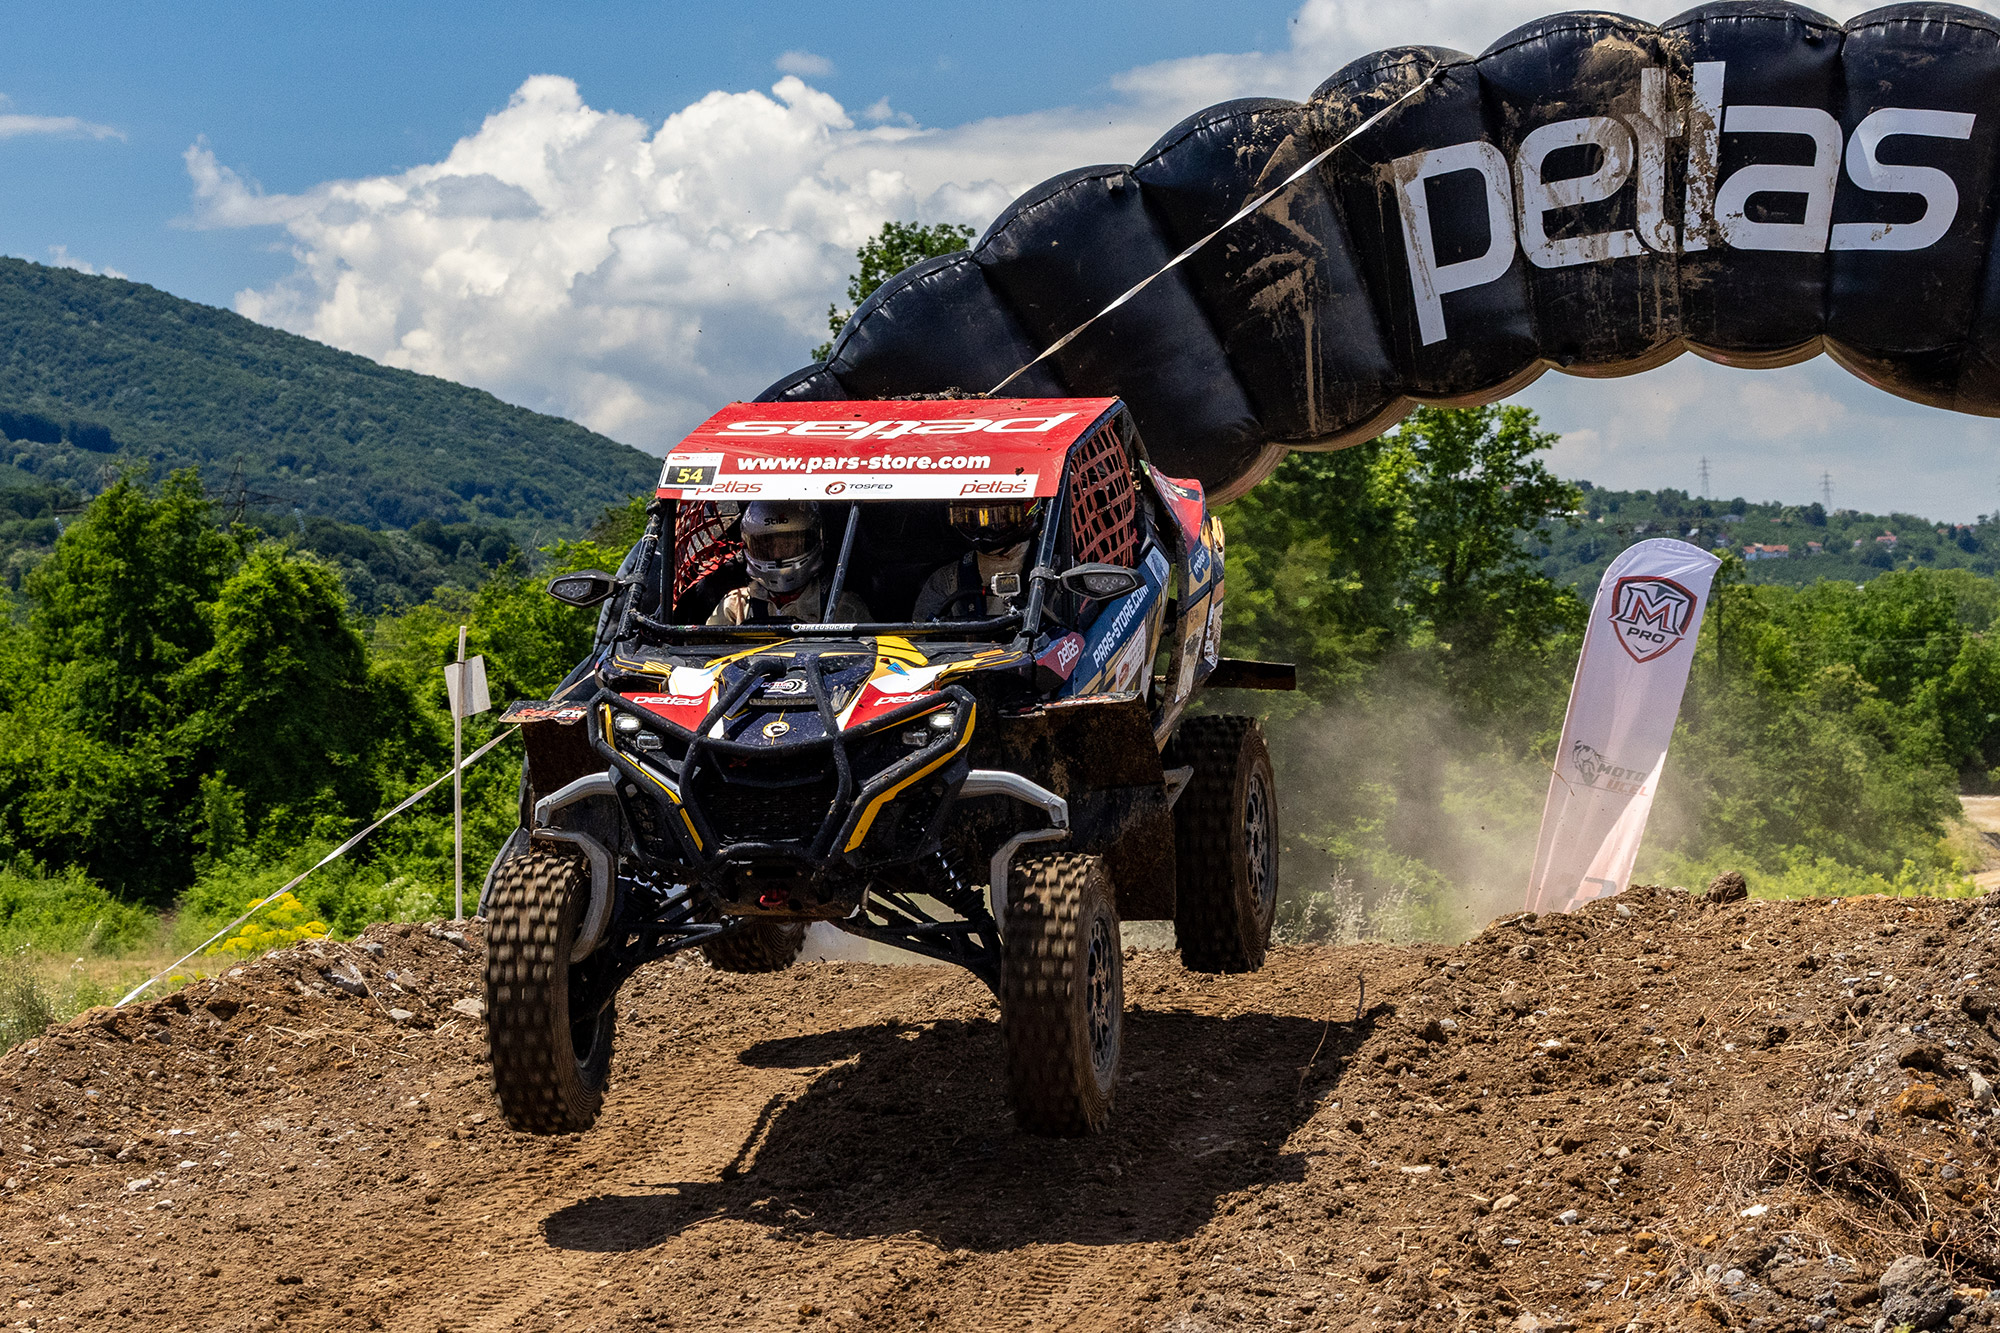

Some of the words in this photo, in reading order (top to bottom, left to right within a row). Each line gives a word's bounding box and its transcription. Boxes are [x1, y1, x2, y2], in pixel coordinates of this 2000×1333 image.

[1392, 61, 1977, 346] petlas
[715, 412, 1079, 440] petlas
[737, 454, 991, 474] www.pars-store.com
[676, 468, 704, 483] 54
[695, 481, 763, 495] petlas
[959, 480, 1028, 496] petlas
[1626, 626, 1666, 644] PRO
[1057, 637, 1080, 672] petlas
[632, 695, 705, 706] petlas
[873, 693, 931, 706] petl
[1597, 763, 1648, 782] MOTO
